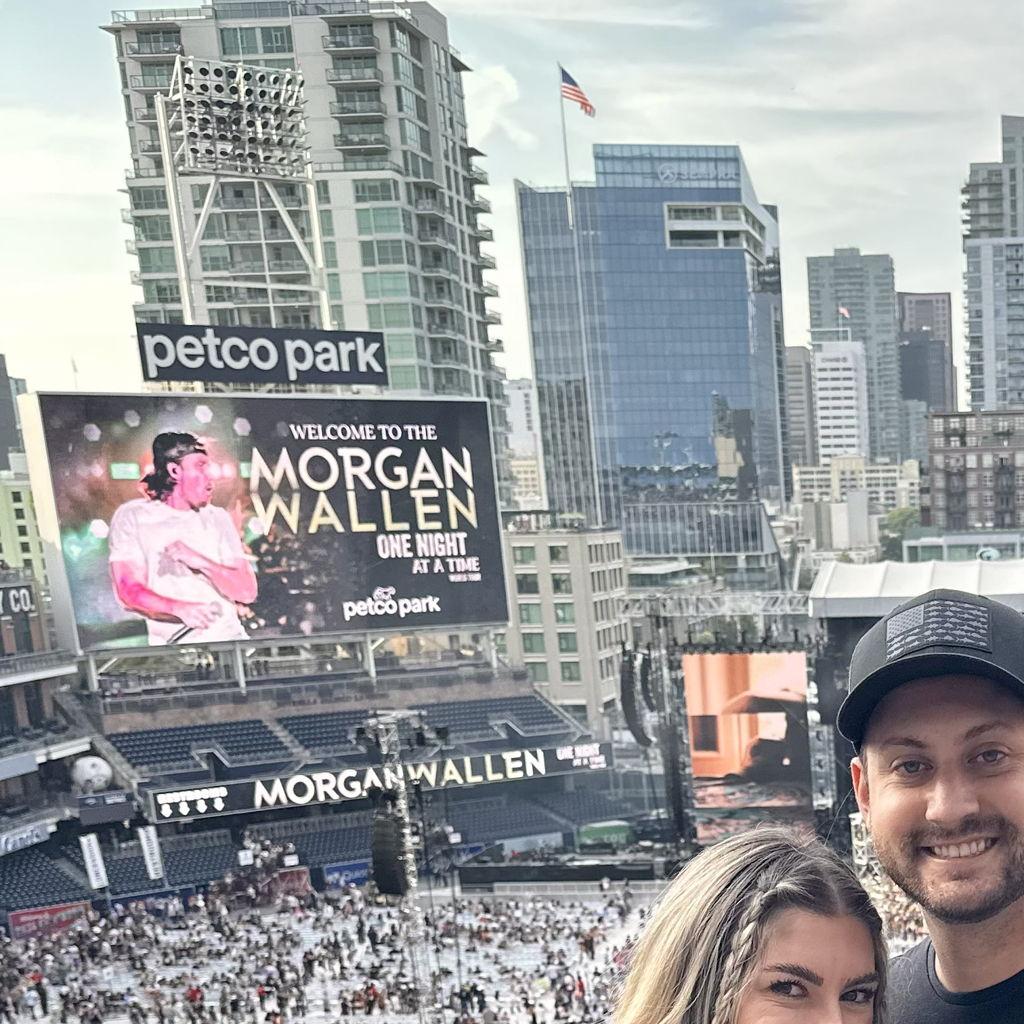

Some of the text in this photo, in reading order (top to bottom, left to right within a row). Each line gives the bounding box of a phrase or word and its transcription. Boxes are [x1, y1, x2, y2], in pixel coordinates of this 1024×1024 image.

[142, 327, 384, 382] petco park
[289, 423, 438, 441] WELCOME TO THE
[250, 446, 475, 491] MORGAN
[250, 488, 479, 536] WALLEN
[376, 532, 468, 559] ONE NIGHT
[412, 556, 481, 574] AT A TIME
[9, 588, 36, 613] CO.
[342, 595, 441, 621] petco park
[254, 749, 546, 809] MORGAN WALLEN
